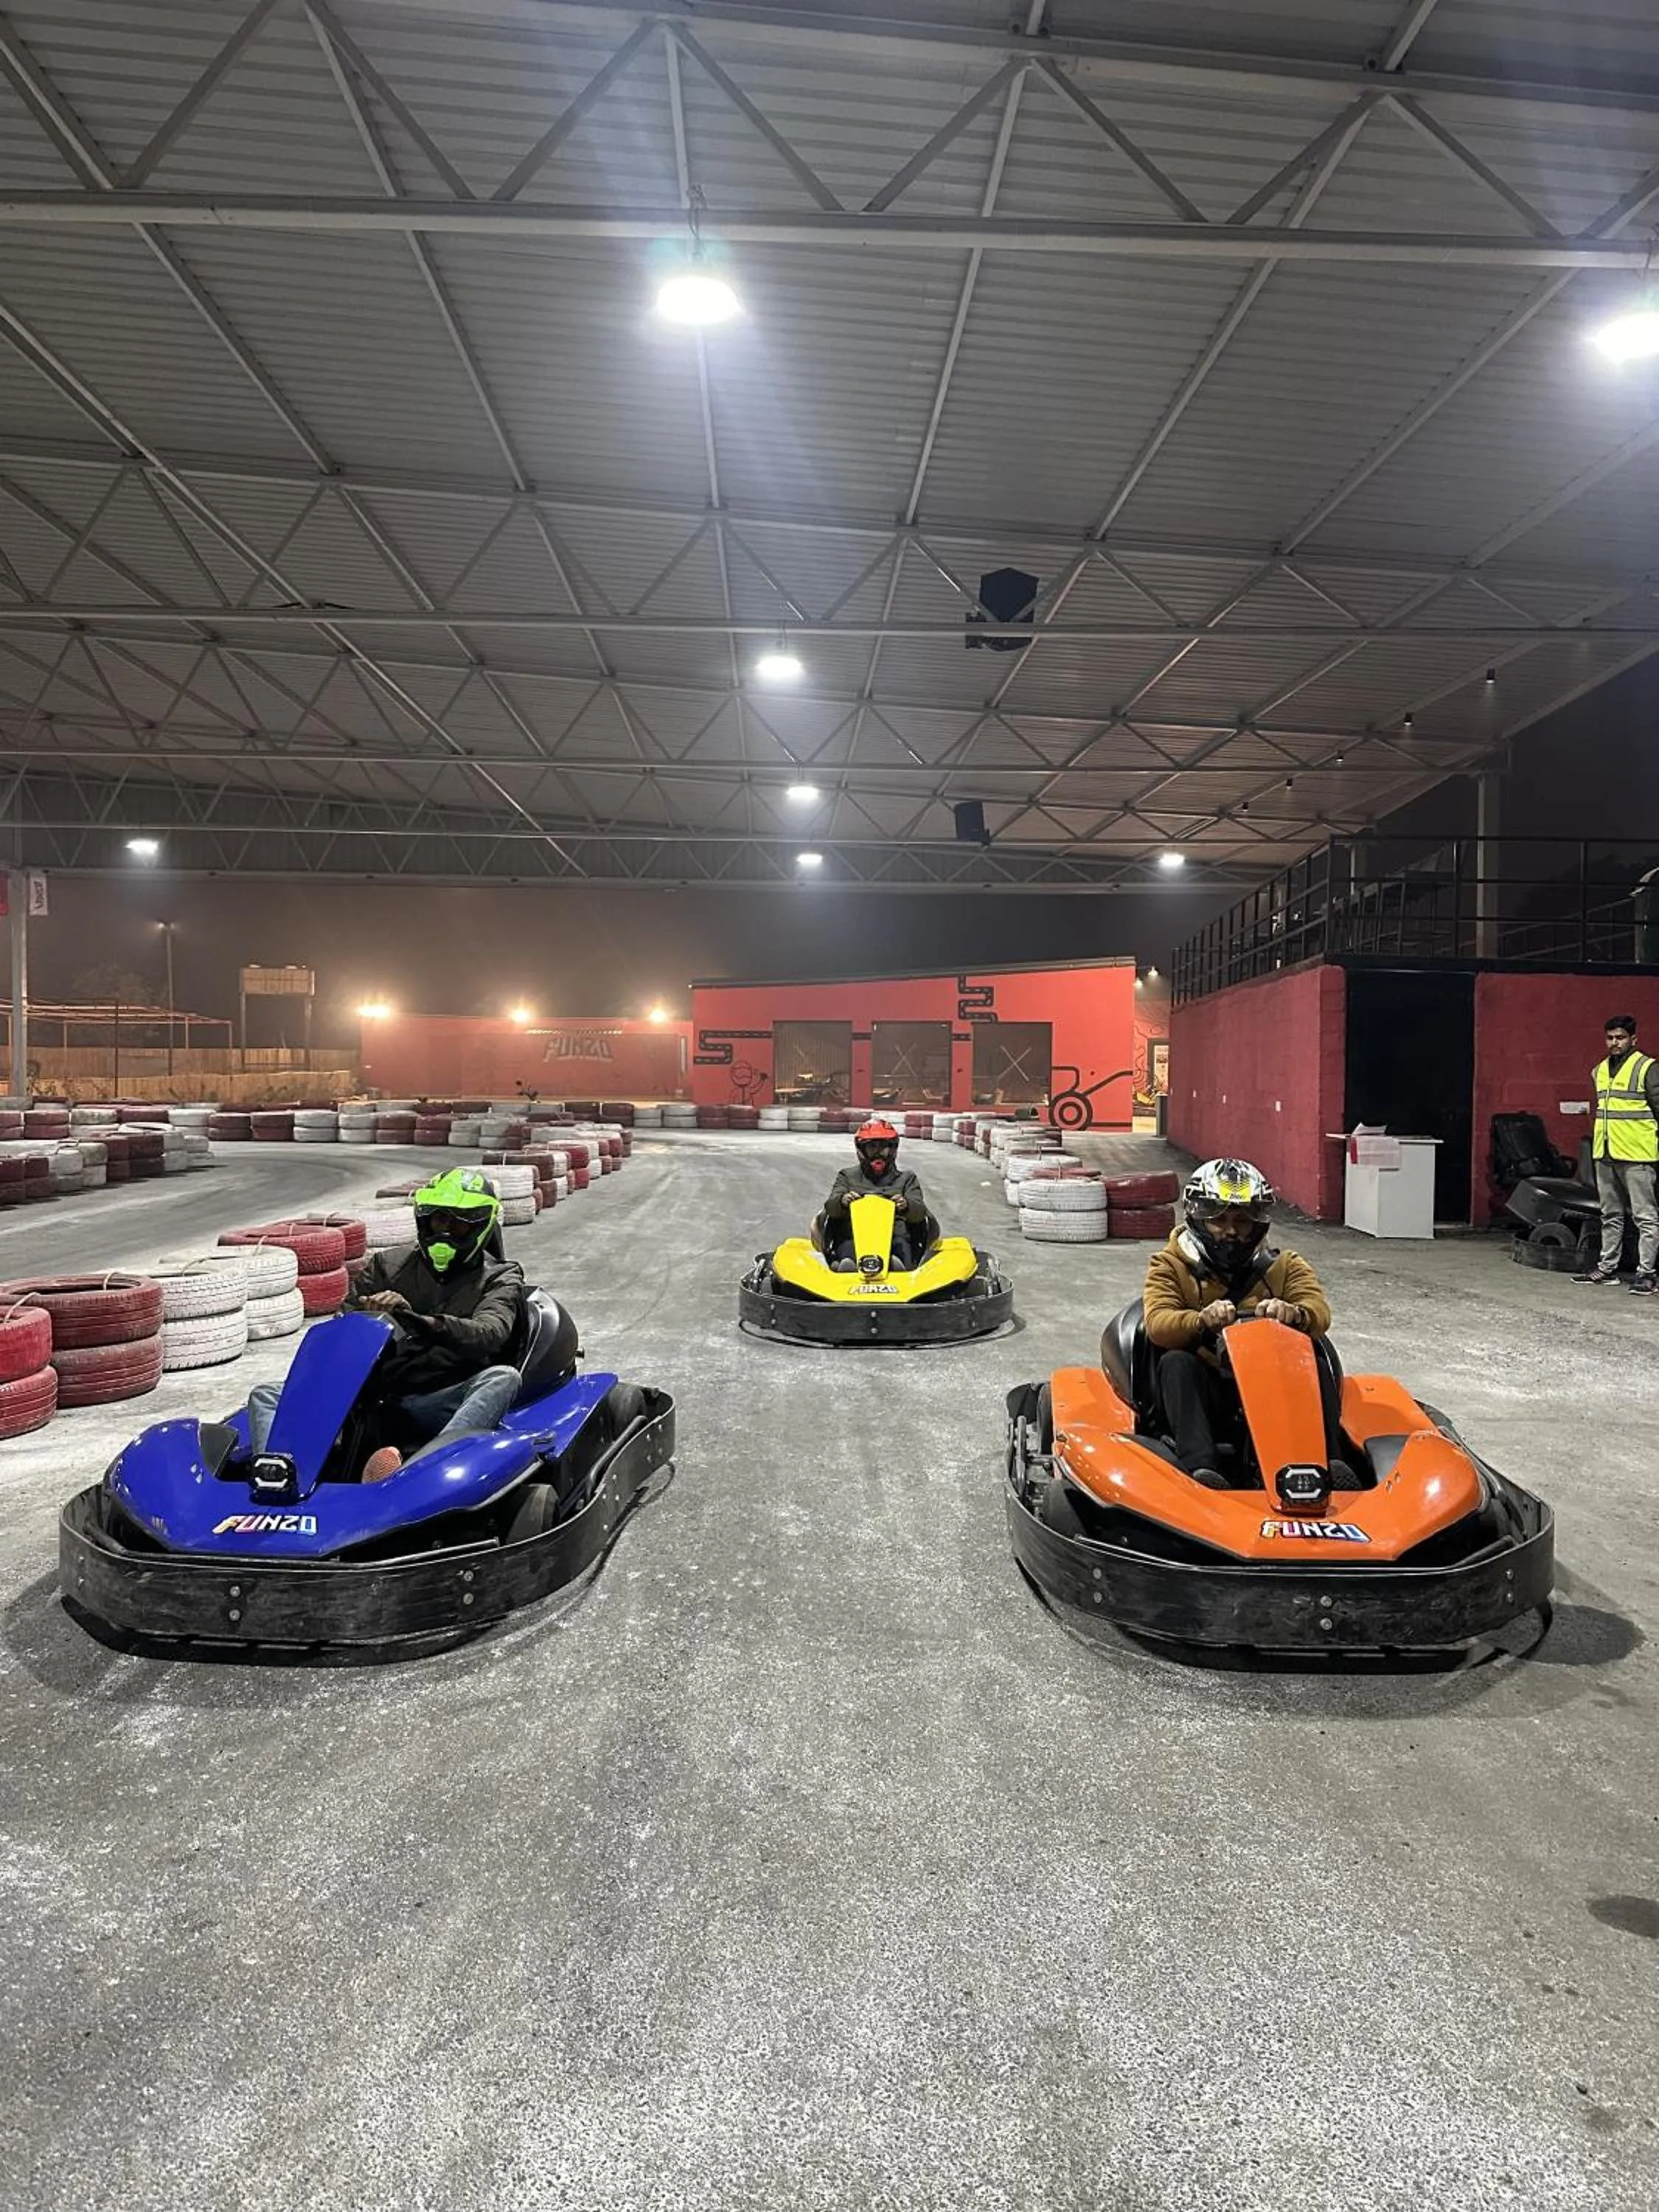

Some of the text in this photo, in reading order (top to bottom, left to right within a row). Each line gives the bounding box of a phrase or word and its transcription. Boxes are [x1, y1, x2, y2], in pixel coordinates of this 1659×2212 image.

[543, 1035, 613, 1062] FUNZO
[849, 1284, 898, 1295] FUNZO
[212, 1514, 318, 1535] FUNZO
[1261, 1520, 1371, 1543] FUNZO
